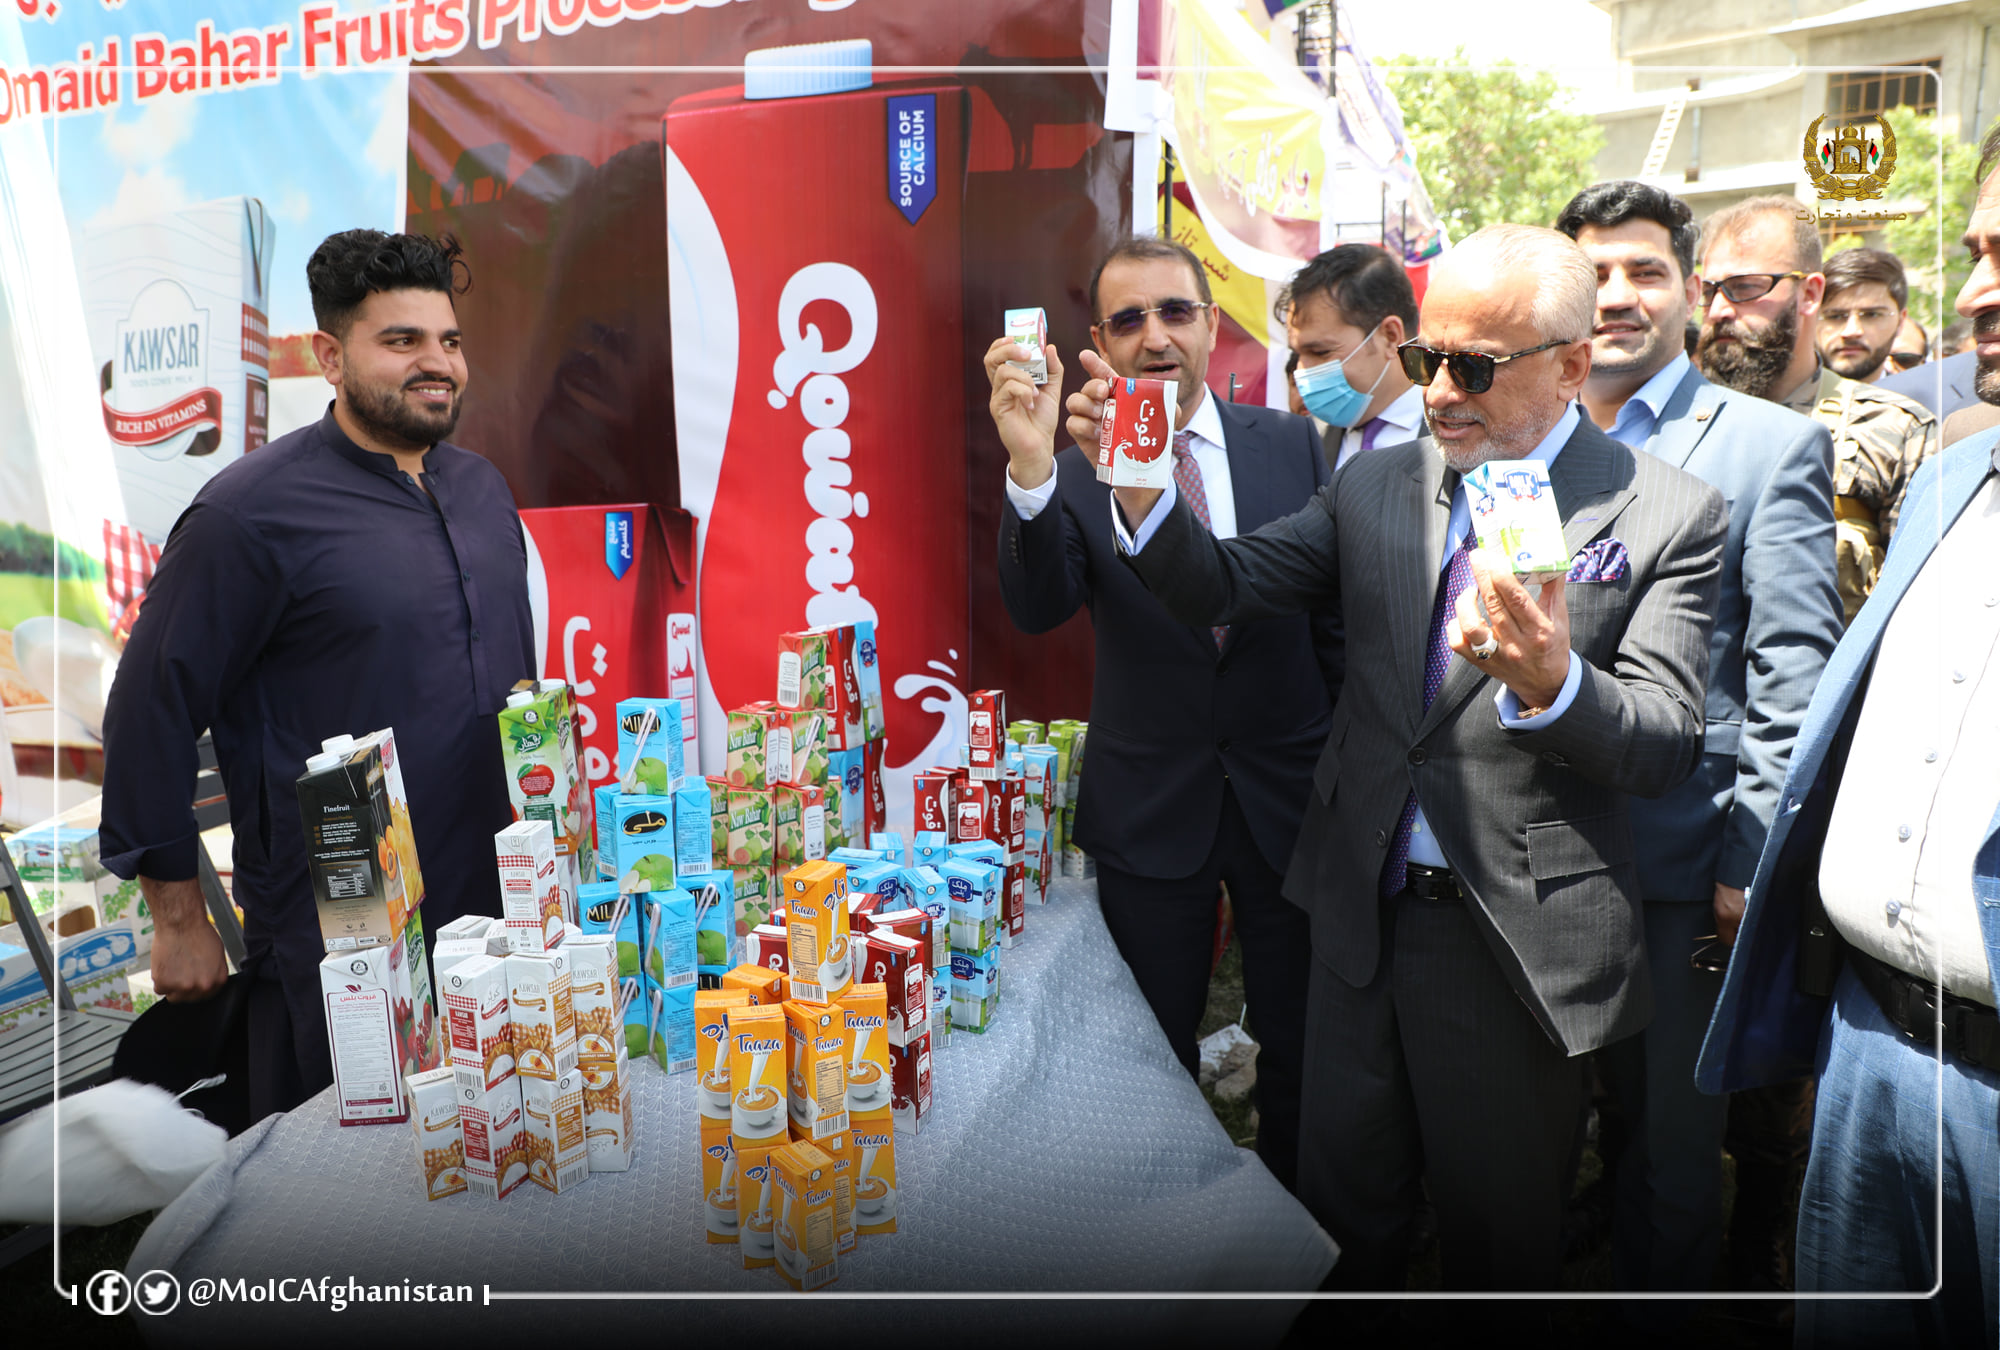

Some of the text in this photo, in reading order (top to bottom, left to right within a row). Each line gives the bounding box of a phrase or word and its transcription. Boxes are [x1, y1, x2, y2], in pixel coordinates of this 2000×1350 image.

[136, 25, 288, 98] Bahar
[304, 0, 465, 74] Fruits
[899, 110, 912, 207] SOURCE OF
[912, 109, 926, 186] CALCIUM
[123, 322, 199, 375] KAWSAR
[115, 399, 207, 434] RICH IN VITAMINS
[1134, 399, 1157, 447] قوت
[608, 520, 619, 544] منبع
[619, 519, 632, 559] کلسیم
[621, 716, 659, 732] MILI
[922, 796, 942, 829] قوت
[787, 899, 818, 917] Taaza
[844, 1010, 885, 1029] Taaza
[732, 1033, 784, 1054] Taaza
[811, 1036, 844, 1052] Taaza
[833, 1158, 851, 1171] aza
[802, 1187, 834, 1206] Taaza
